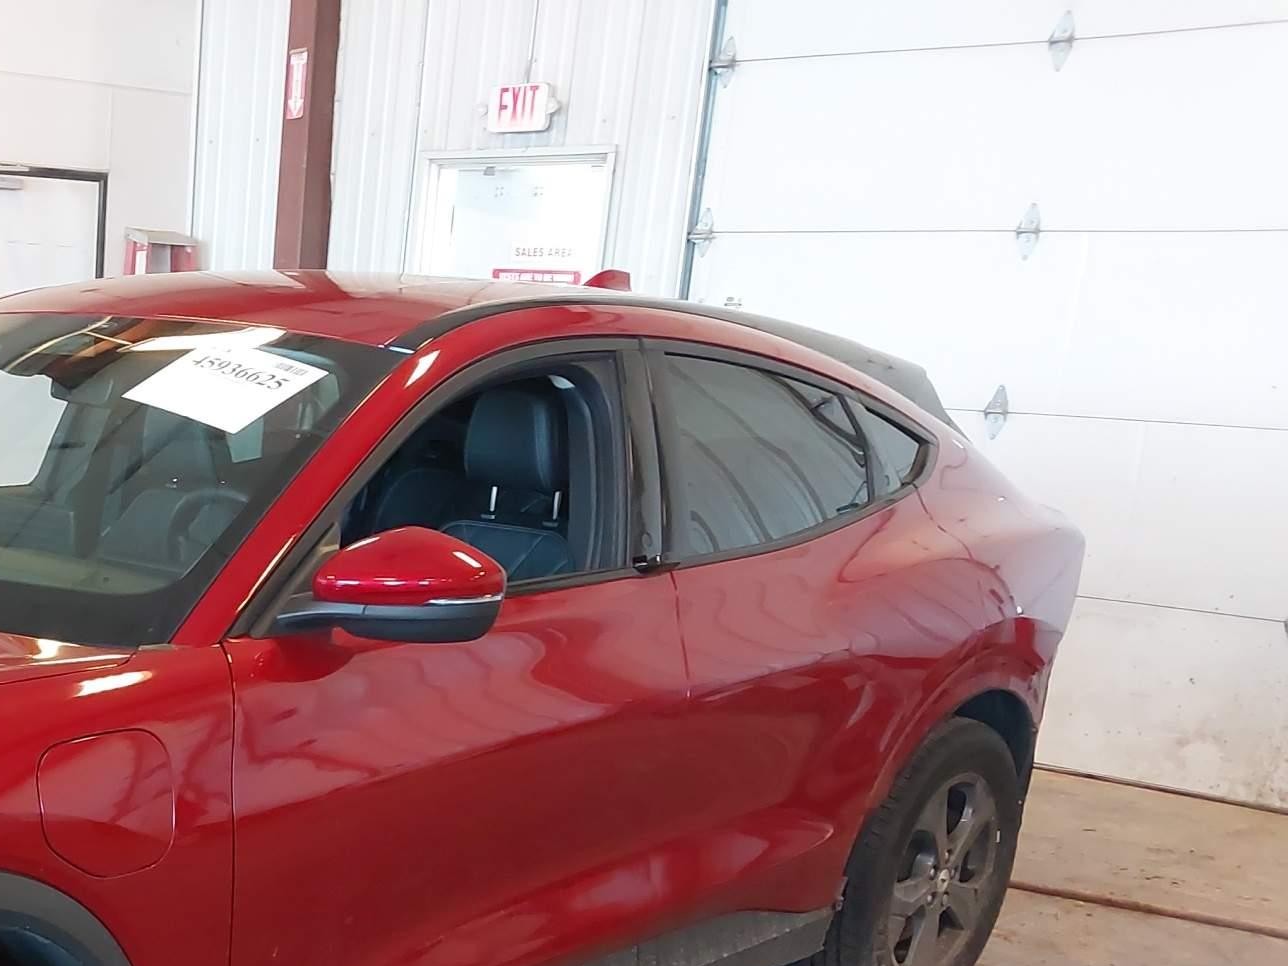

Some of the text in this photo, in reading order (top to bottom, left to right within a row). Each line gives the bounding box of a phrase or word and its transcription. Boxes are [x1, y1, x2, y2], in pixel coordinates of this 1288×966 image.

[497, 85, 539, 125] EXIT
[515, 247, 544, 257] SALES
[192, 355, 290, 390] 45936625
